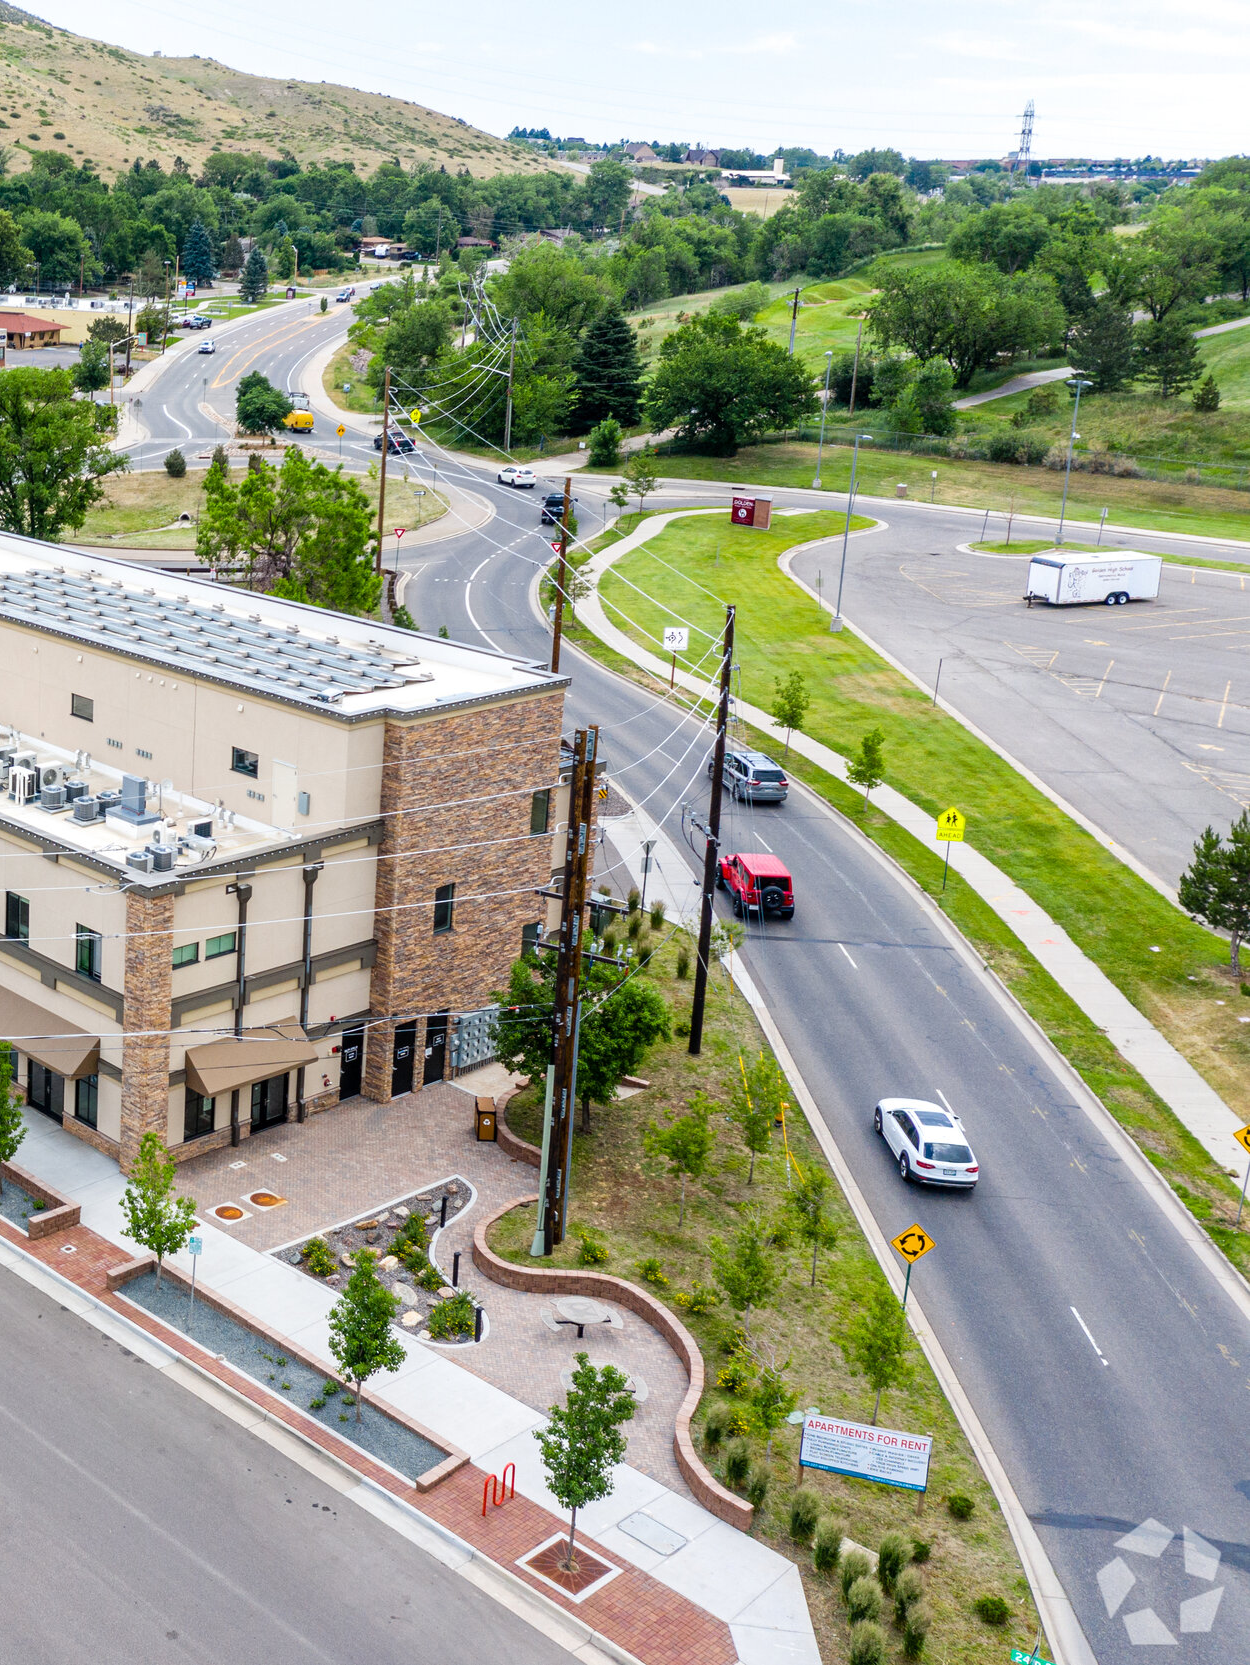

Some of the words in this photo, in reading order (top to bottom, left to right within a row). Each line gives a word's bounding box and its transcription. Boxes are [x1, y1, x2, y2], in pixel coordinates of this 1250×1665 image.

[807, 1420, 874, 1442] APARTMENTS
[877, 1434, 898, 1446] FOR
[900, 1440, 928, 1452] RENT
